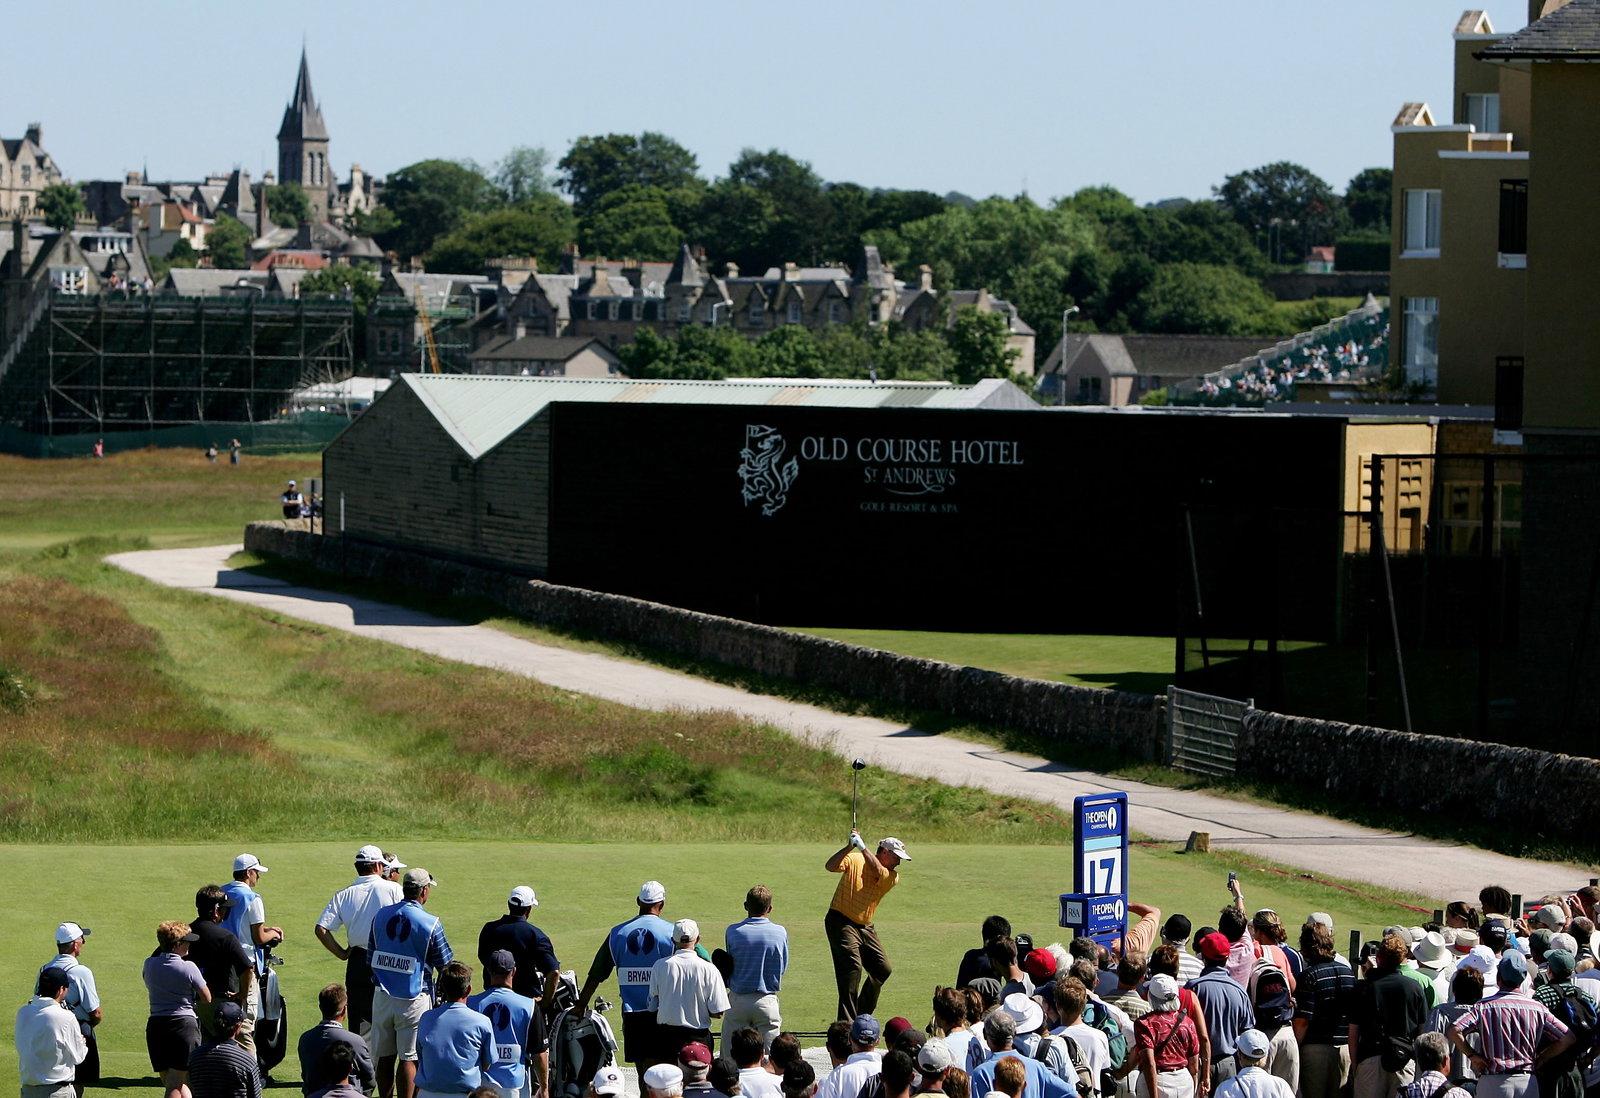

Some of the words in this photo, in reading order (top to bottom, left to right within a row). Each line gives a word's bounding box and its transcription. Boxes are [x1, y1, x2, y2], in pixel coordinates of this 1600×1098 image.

[801, 436, 848, 460] OLD
[857, 438, 942, 463] COURSE
[951, 440, 1025, 465] HOTEL
[883, 468, 956, 486] ANDREWS
[860, 502, 885, 512] GOLF
[890, 502, 926, 513] RESORT
[930, 503, 937, 513] &
[941, 503, 958, 513] SPA
[1090, 858, 1115, 894] 17
[376, 954, 410, 970] NICKLAUS
[497, 1047, 512, 1060] LES
